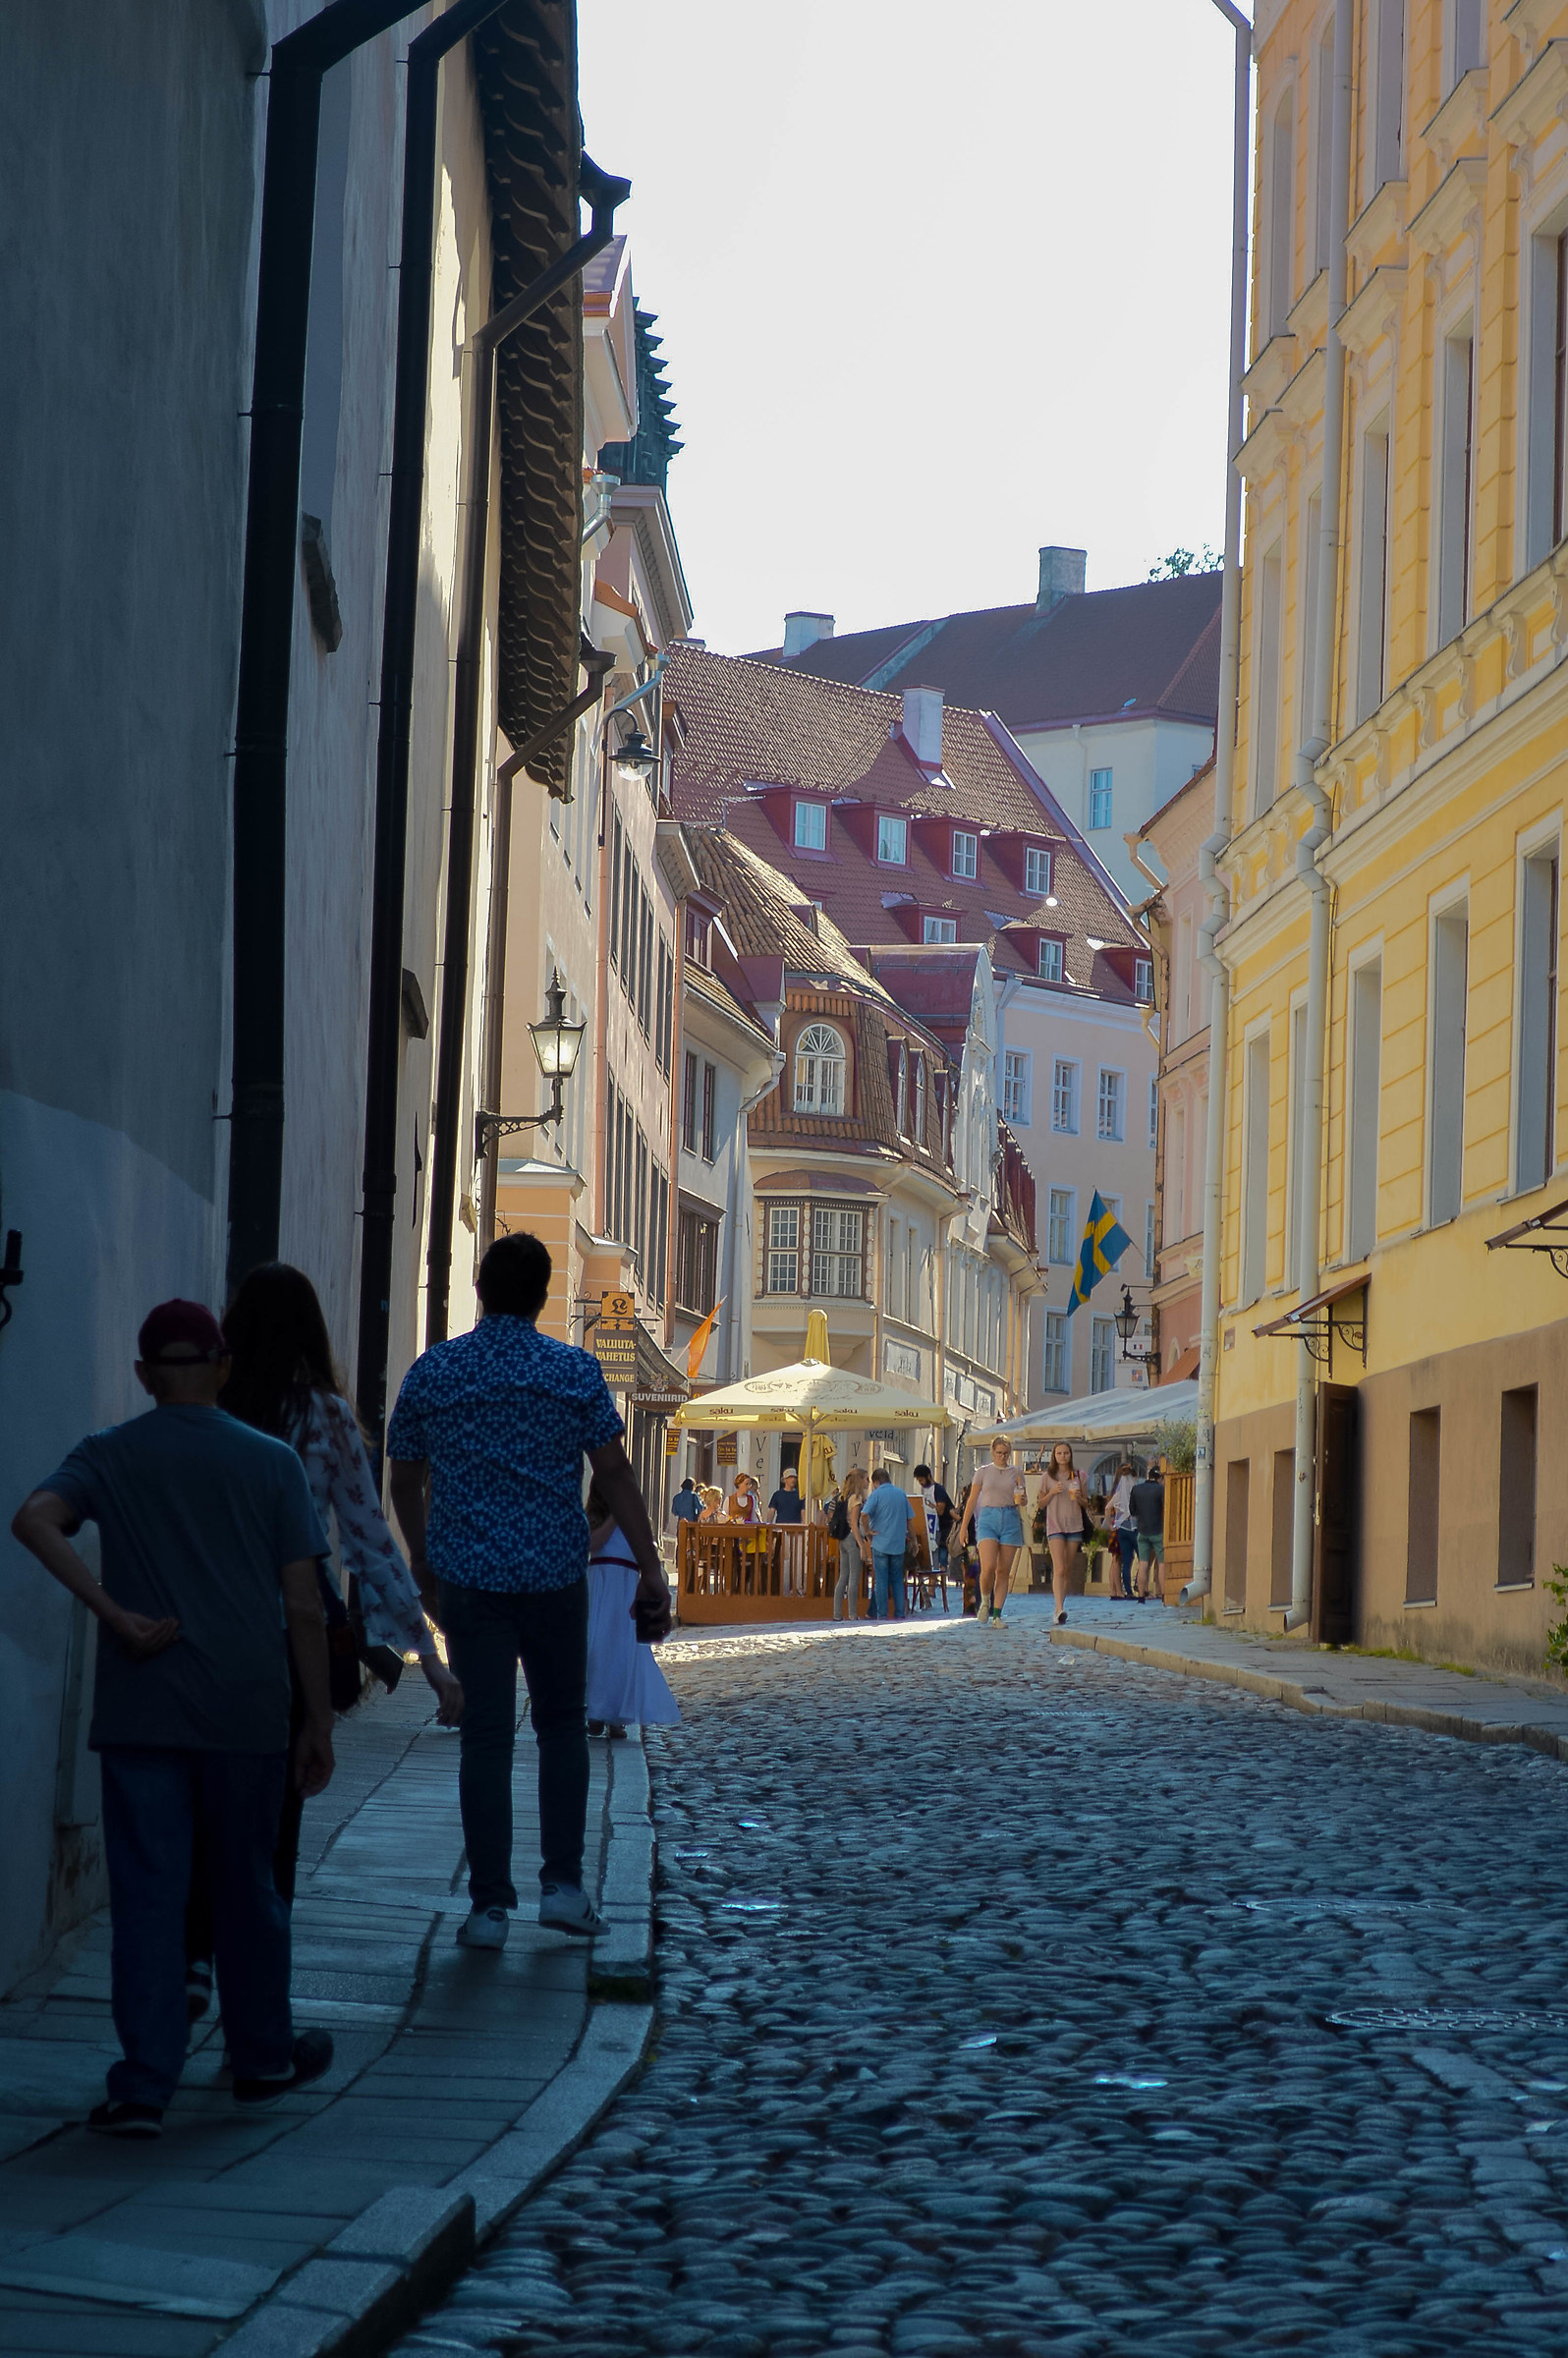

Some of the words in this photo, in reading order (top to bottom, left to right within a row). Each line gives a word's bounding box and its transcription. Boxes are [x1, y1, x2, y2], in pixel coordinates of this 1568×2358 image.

[595, 1351, 636, 1363] VAHETUS
[631, 1392, 688, 1403] SUVENIIRID
[708, 1406, 734, 1416] saku
[894, 1409, 920, 1418] saku
